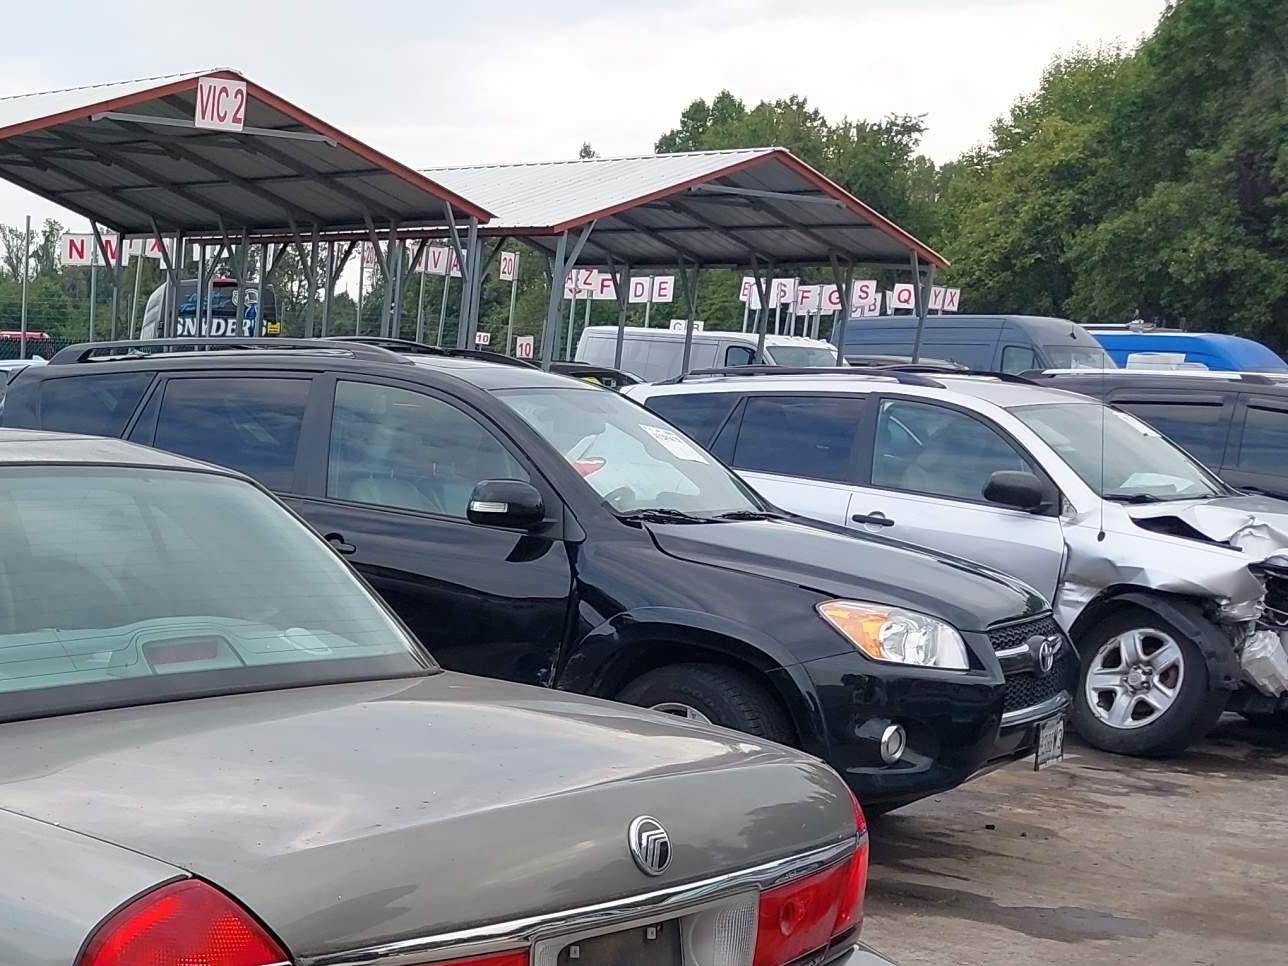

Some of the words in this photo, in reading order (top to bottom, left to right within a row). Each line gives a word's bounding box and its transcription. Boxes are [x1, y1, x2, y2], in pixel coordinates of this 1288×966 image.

[200, 83, 229, 122] VIC
[232, 88, 244, 123] 2
[68, 239, 85, 259] N
[433, 245, 441, 268] V
[503, 259, 512, 275] 20
[583, 268, 593, 285] Z
[600, 278, 613, 294] F
[634, 282, 645, 297] D
[658, 281, 668, 297] E
[858, 285, 870, 300] S
[800, 289, 811, 305] F
[897, 289, 912, 304] Q
[934, 289, 941, 305] Y
[947, 291, 957, 306] X
[476, 334, 489, 343] 10
[518, 342, 531, 357] 10
